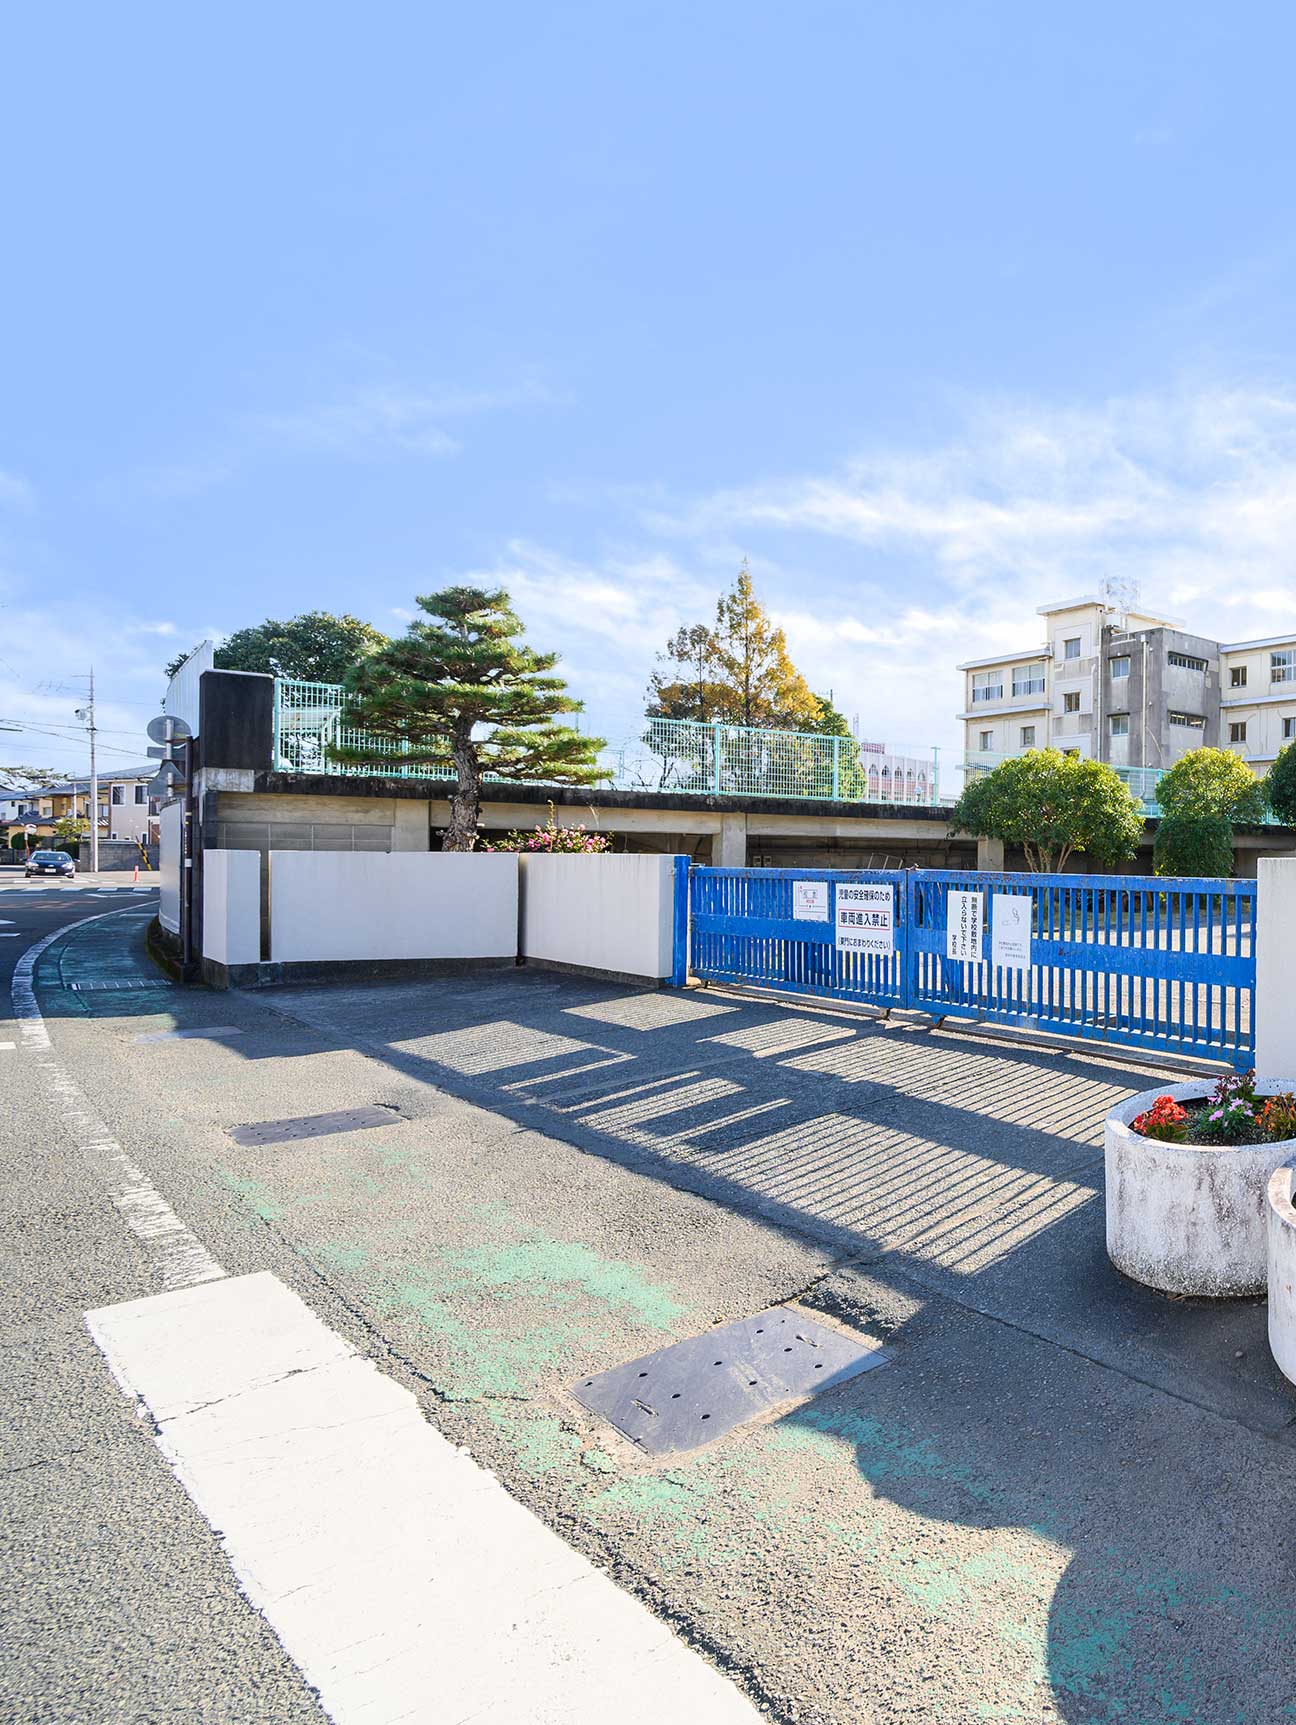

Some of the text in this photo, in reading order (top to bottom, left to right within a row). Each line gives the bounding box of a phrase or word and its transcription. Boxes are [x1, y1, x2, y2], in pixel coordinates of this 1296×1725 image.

[840, 911, 888, 927] 車両進入禁止
[960, 895, 968, 957] 立入らないで下さい
